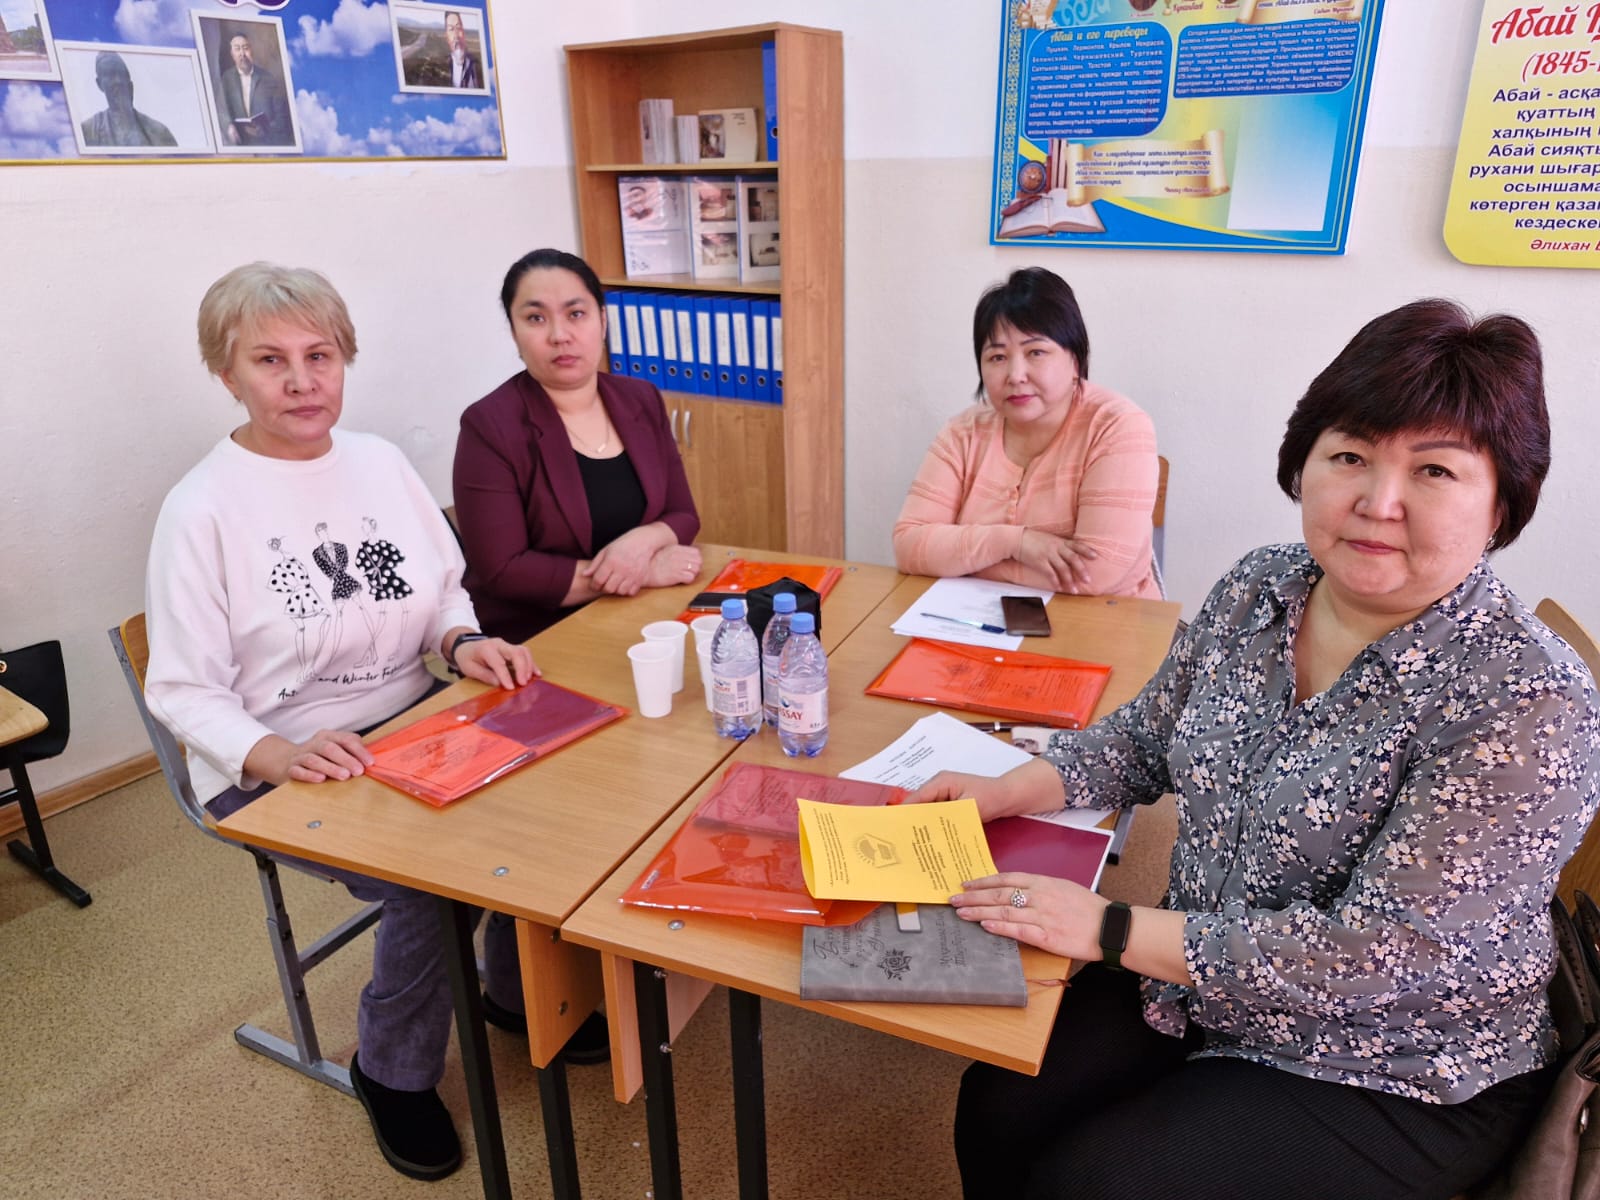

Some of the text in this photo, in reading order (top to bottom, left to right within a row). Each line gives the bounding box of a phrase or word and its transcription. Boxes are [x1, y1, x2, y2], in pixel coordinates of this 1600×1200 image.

[1492, 6, 1579, 44] Абай
[1493, 88, 1540, 102] Абай
[1517, 108, 1595, 122] қуаттың
[1492, 126, 1591, 140] халқының
[1488, 144, 1535, 157] Абай
[1470, 164, 1534, 178] рухани
[1470, 200, 1600, 213] көтерген қаза
[1515, 218, 1600, 230] кездеске
[1530, 239, 1590, 250] Әлихан
[318, 676, 340, 684] and
[343, 672, 378, 685] Winter
